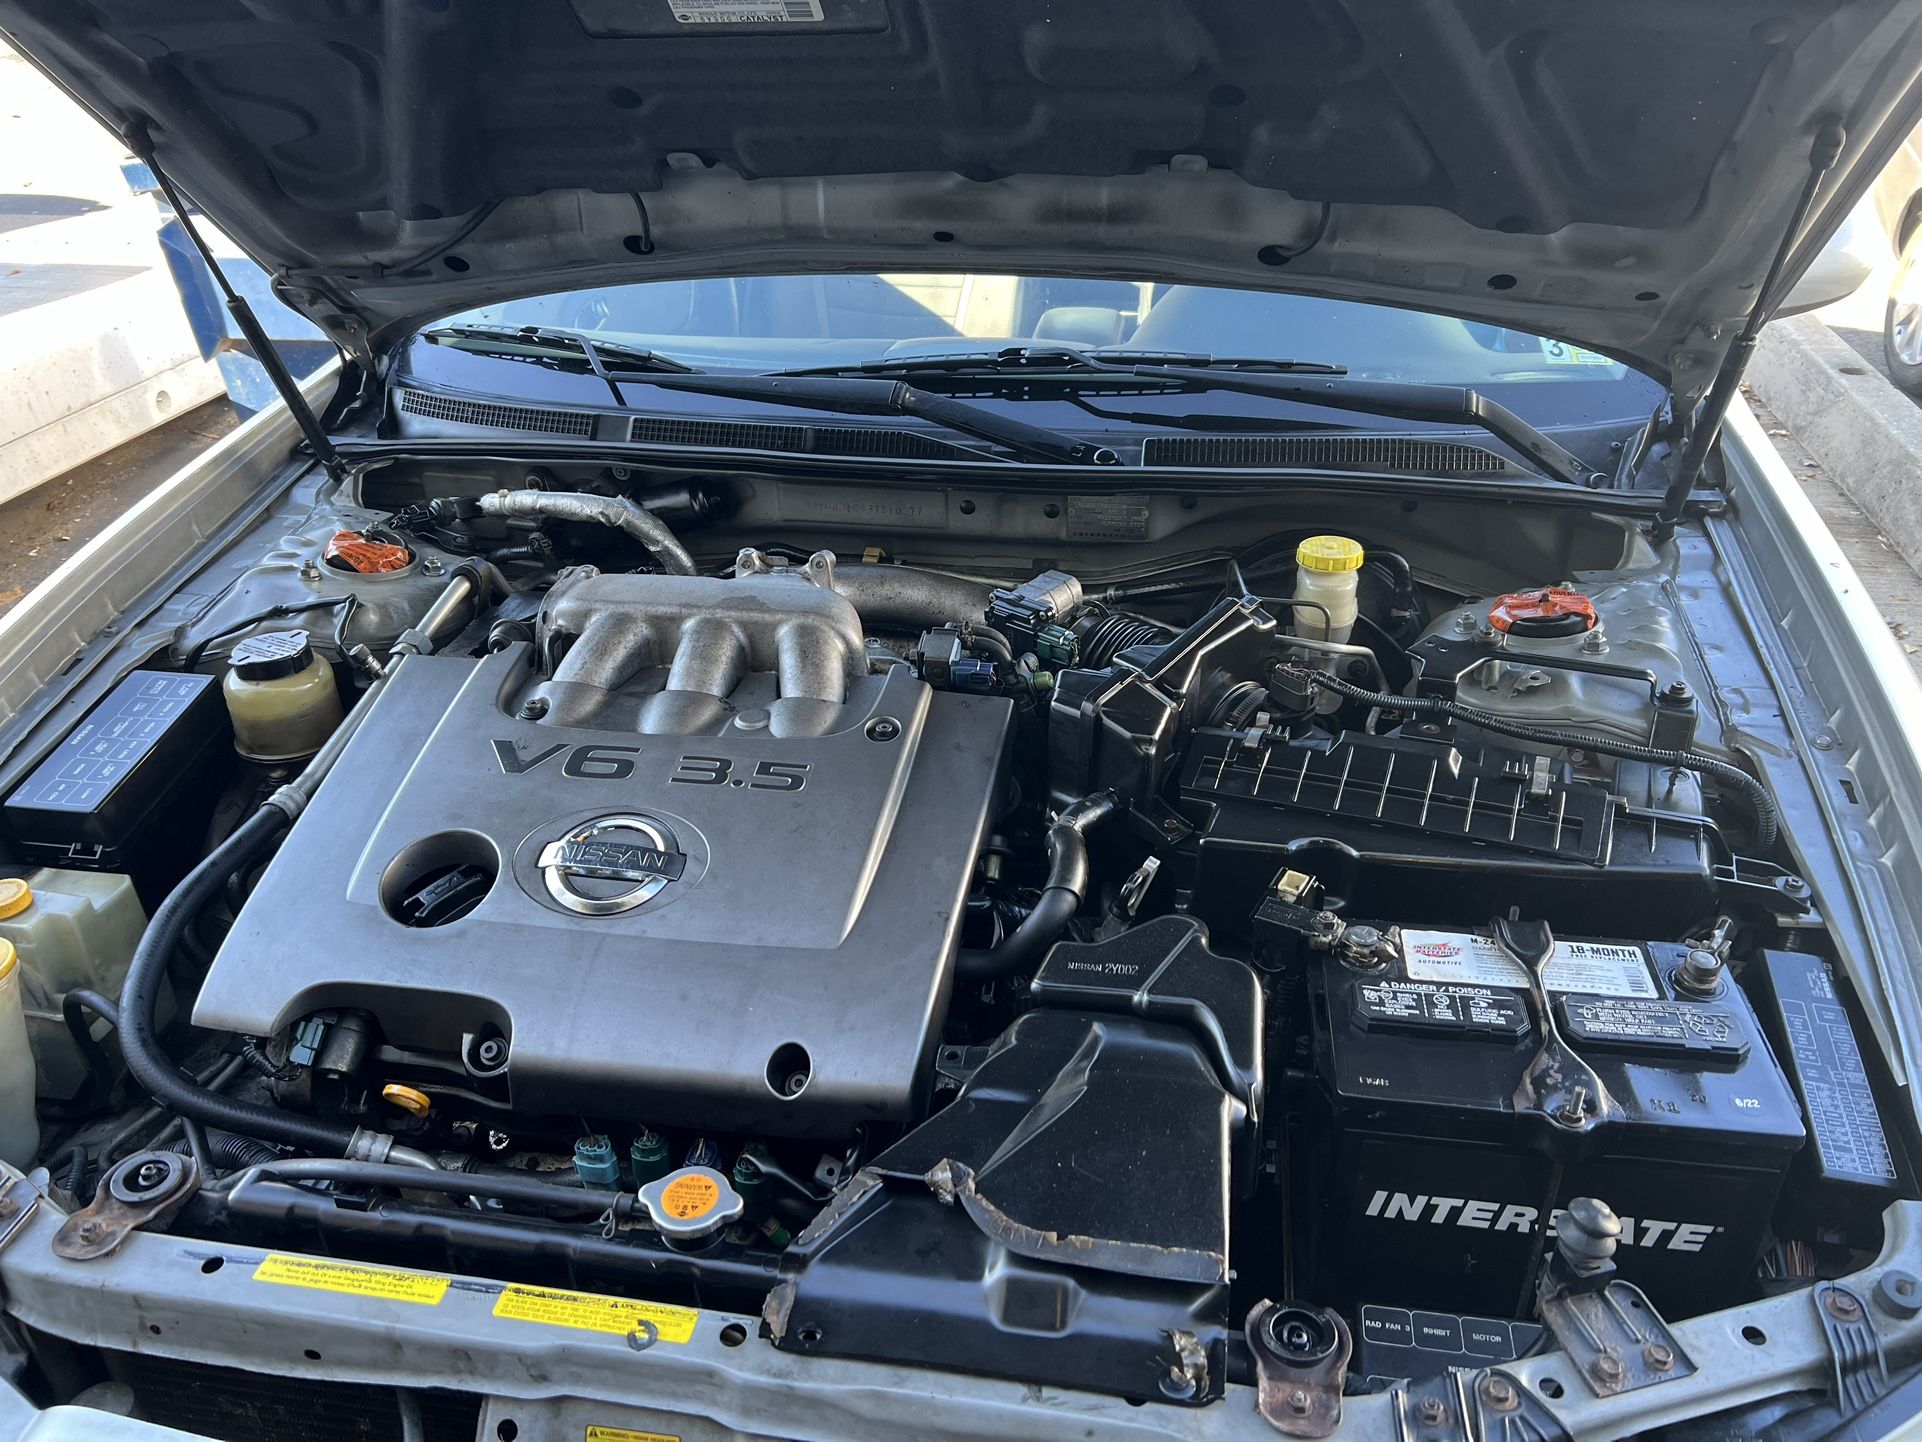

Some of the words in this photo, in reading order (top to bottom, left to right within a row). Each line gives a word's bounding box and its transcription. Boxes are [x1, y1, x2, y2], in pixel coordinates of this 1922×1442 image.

[491, 739, 643, 780] V6
[667, 754, 813, 793] 3.5
[554, 844, 669, 871] NISSAN
[1568, 944, 1639, 959] 18-MONTH
[1067, 961, 1102, 972] NISSAN
[1390, 981, 1437, 992] DANGER
[1448, 986, 1492, 996] POISON
[1365, 1189, 1716, 1253] INTERATE
[1365, 1319, 1382, 1329] RAD
[1385, 1321, 1401, 1331] FAN
[1423, 1327, 1451, 1337] INHIBIT
[1472, 1333, 1502, 1343] MOTOR
